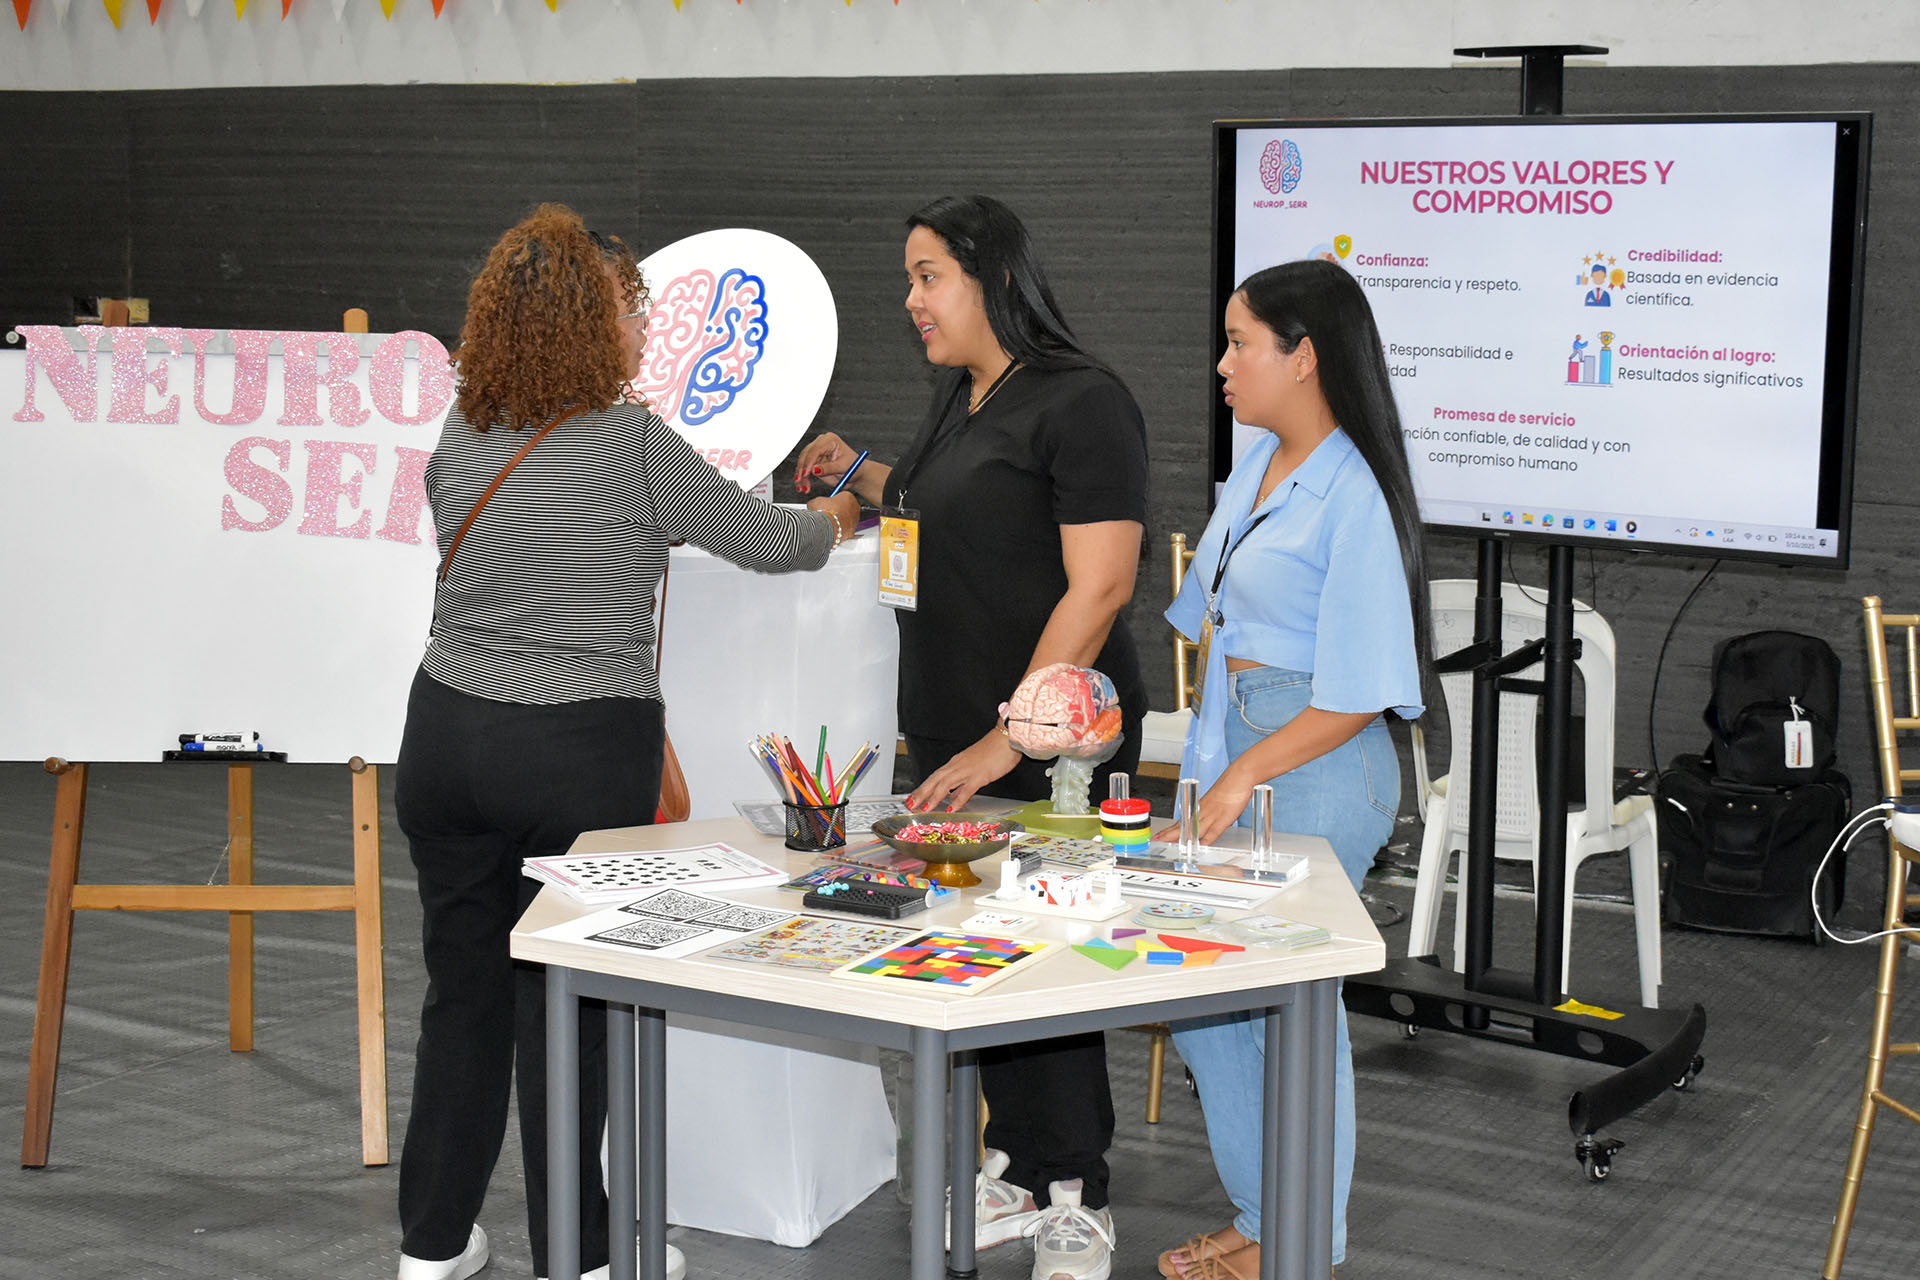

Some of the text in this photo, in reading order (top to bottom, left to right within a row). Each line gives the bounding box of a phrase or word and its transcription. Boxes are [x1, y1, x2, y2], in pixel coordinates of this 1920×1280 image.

[1361, 160, 1675, 185] NUESTROS VALORES Y
[1412, 189, 1613, 214] COMPROMISO
[1356, 254, 1429, 267] Confianza:
[1627, 249, 1723, 263] Credibilidad:
[1356, 275, 1521, 294] Transparencia y respeto.
[1626, 271, 1779, 287] Basada en evidencia
[1625, 291, 1694, 306] científica.
[1389, 343, 1514, 360] Responsabilidad e
[1618, 344, 1776, 366] Orientación al logro:
[13, 325, 455, 427] NEURO
[1618, 367, 1804, 389] Resultados significativos
[1433, 407, 1576, 427] Promesa de servicio
[1443, 429, 1510, 447] confiable,
[1512, 433, 1531, 447] de
[1534, 435, 1588, 450] calidad
[1591, 441, 1601, 455] y
[1603, 441, 1631, 453] con
[1428, 451, 1578, 472] compromiso humano
